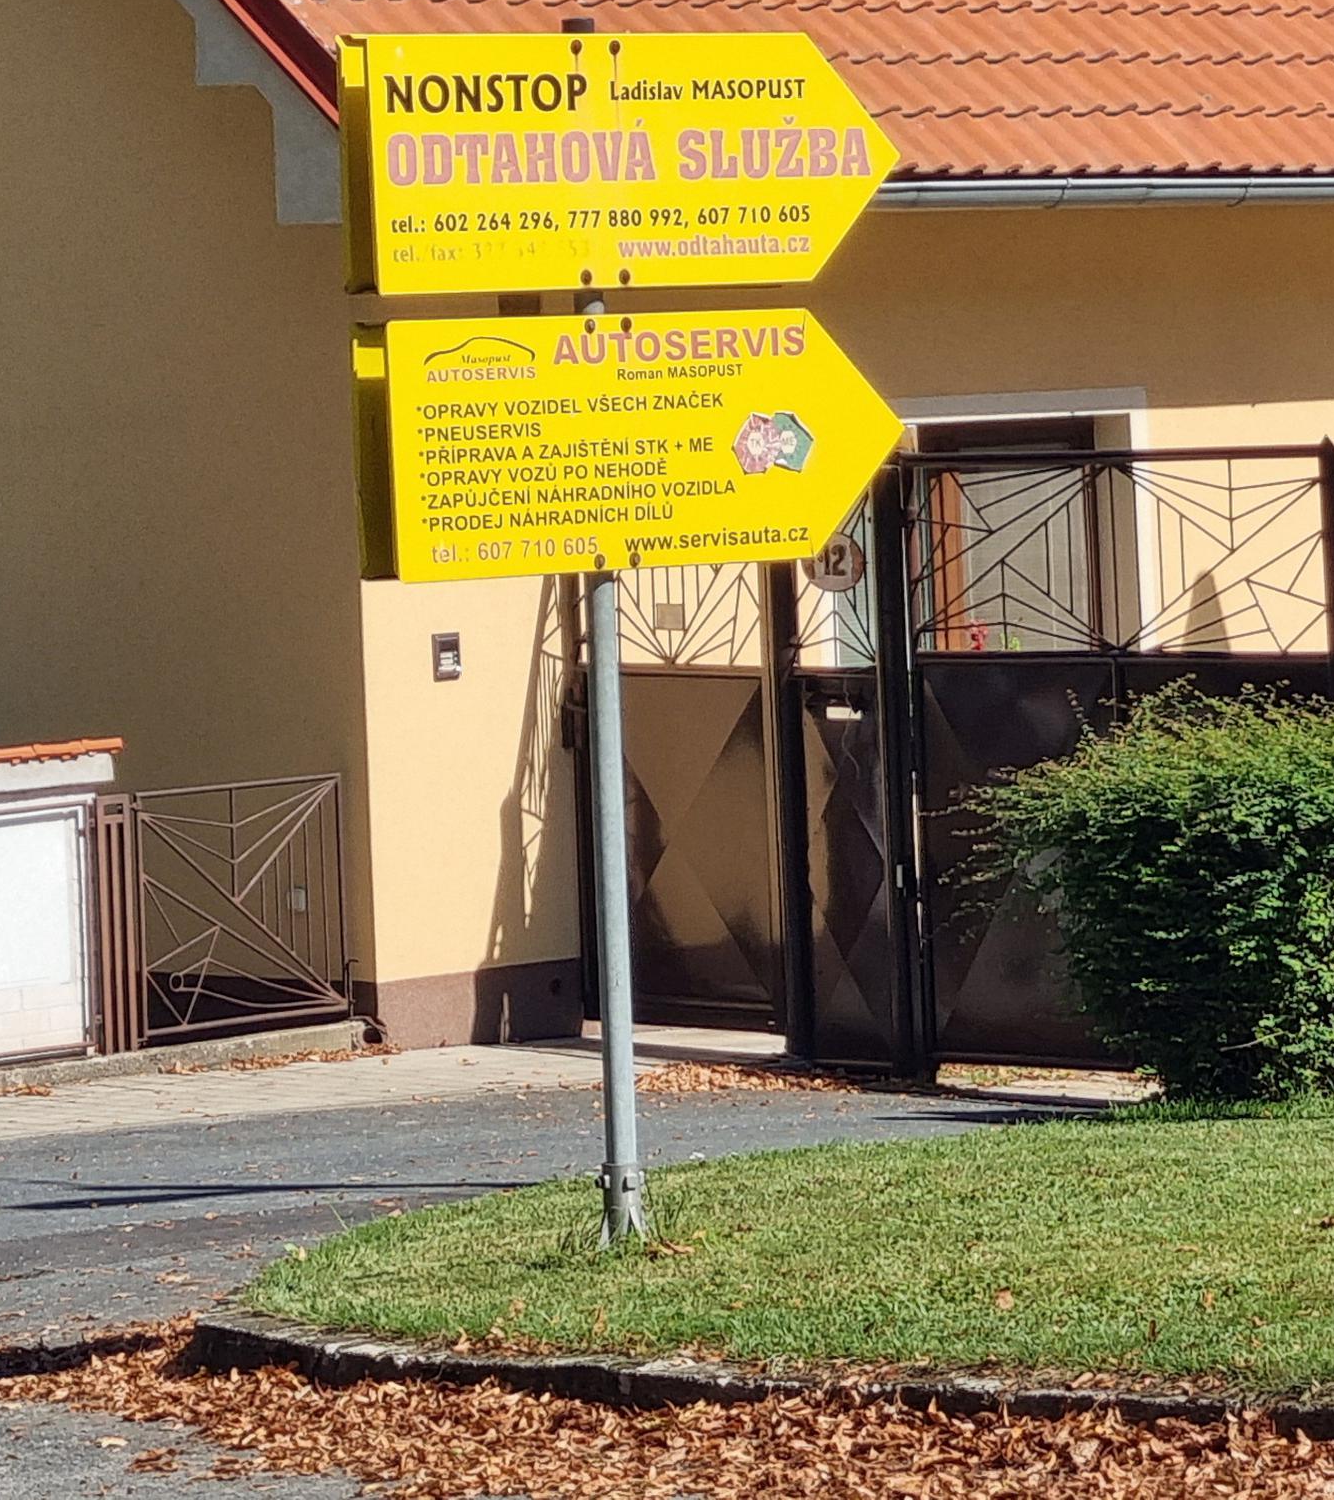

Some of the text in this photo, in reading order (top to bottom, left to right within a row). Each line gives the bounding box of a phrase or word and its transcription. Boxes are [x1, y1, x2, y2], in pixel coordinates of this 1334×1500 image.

[384, 73, 587, 113] NONSTOP
[610, 79, 805, 100] Ladislav MASOPUST
[387, 116, 871, 185] ODTAHOVÁ SLUŽBA
[391, 205, 810, 233] tel.: 602 264 296, 777 880 992, 607 710 605
[618, 234, 810, 257] www.odtahauta.cz
[554, 326, 805, 365] AUTOSERVIS
[427, 366, 536, 382] AUTOSERVIS
[617, 364, 743, 381] Roman MASOPUST
[504, 398, 581, 416] VOZIDEL
[588, 393, 647, 413] VŠECH
[653, 390, 723, 411] ZNAČEK
[522, 445, 534, 460] A
[539, 437, 628, 460] ZAJIŠTĚNÍ
[635, 440, 669, 455] STK
[689, 437, 713, 452] ME
[508, 462, 556, 482] VOZŮ
[564, 465, 587, 480] PO
[595, 458, 667, 479] NEHODĚ
[538, 481, 656, 503] NÁHRADNÍHO
[662, 479, 736, 497] VOZIDLA
[510, 504, 628, 527] NÁHRADNÍCH
[635, 501, 673, 521] DÍLŮ
[432, 536, 598, 563] tel.: 607 710 605
[625, 527, 808, 552] www.servisauta.cz
[824, 544, 847, 576] 12
